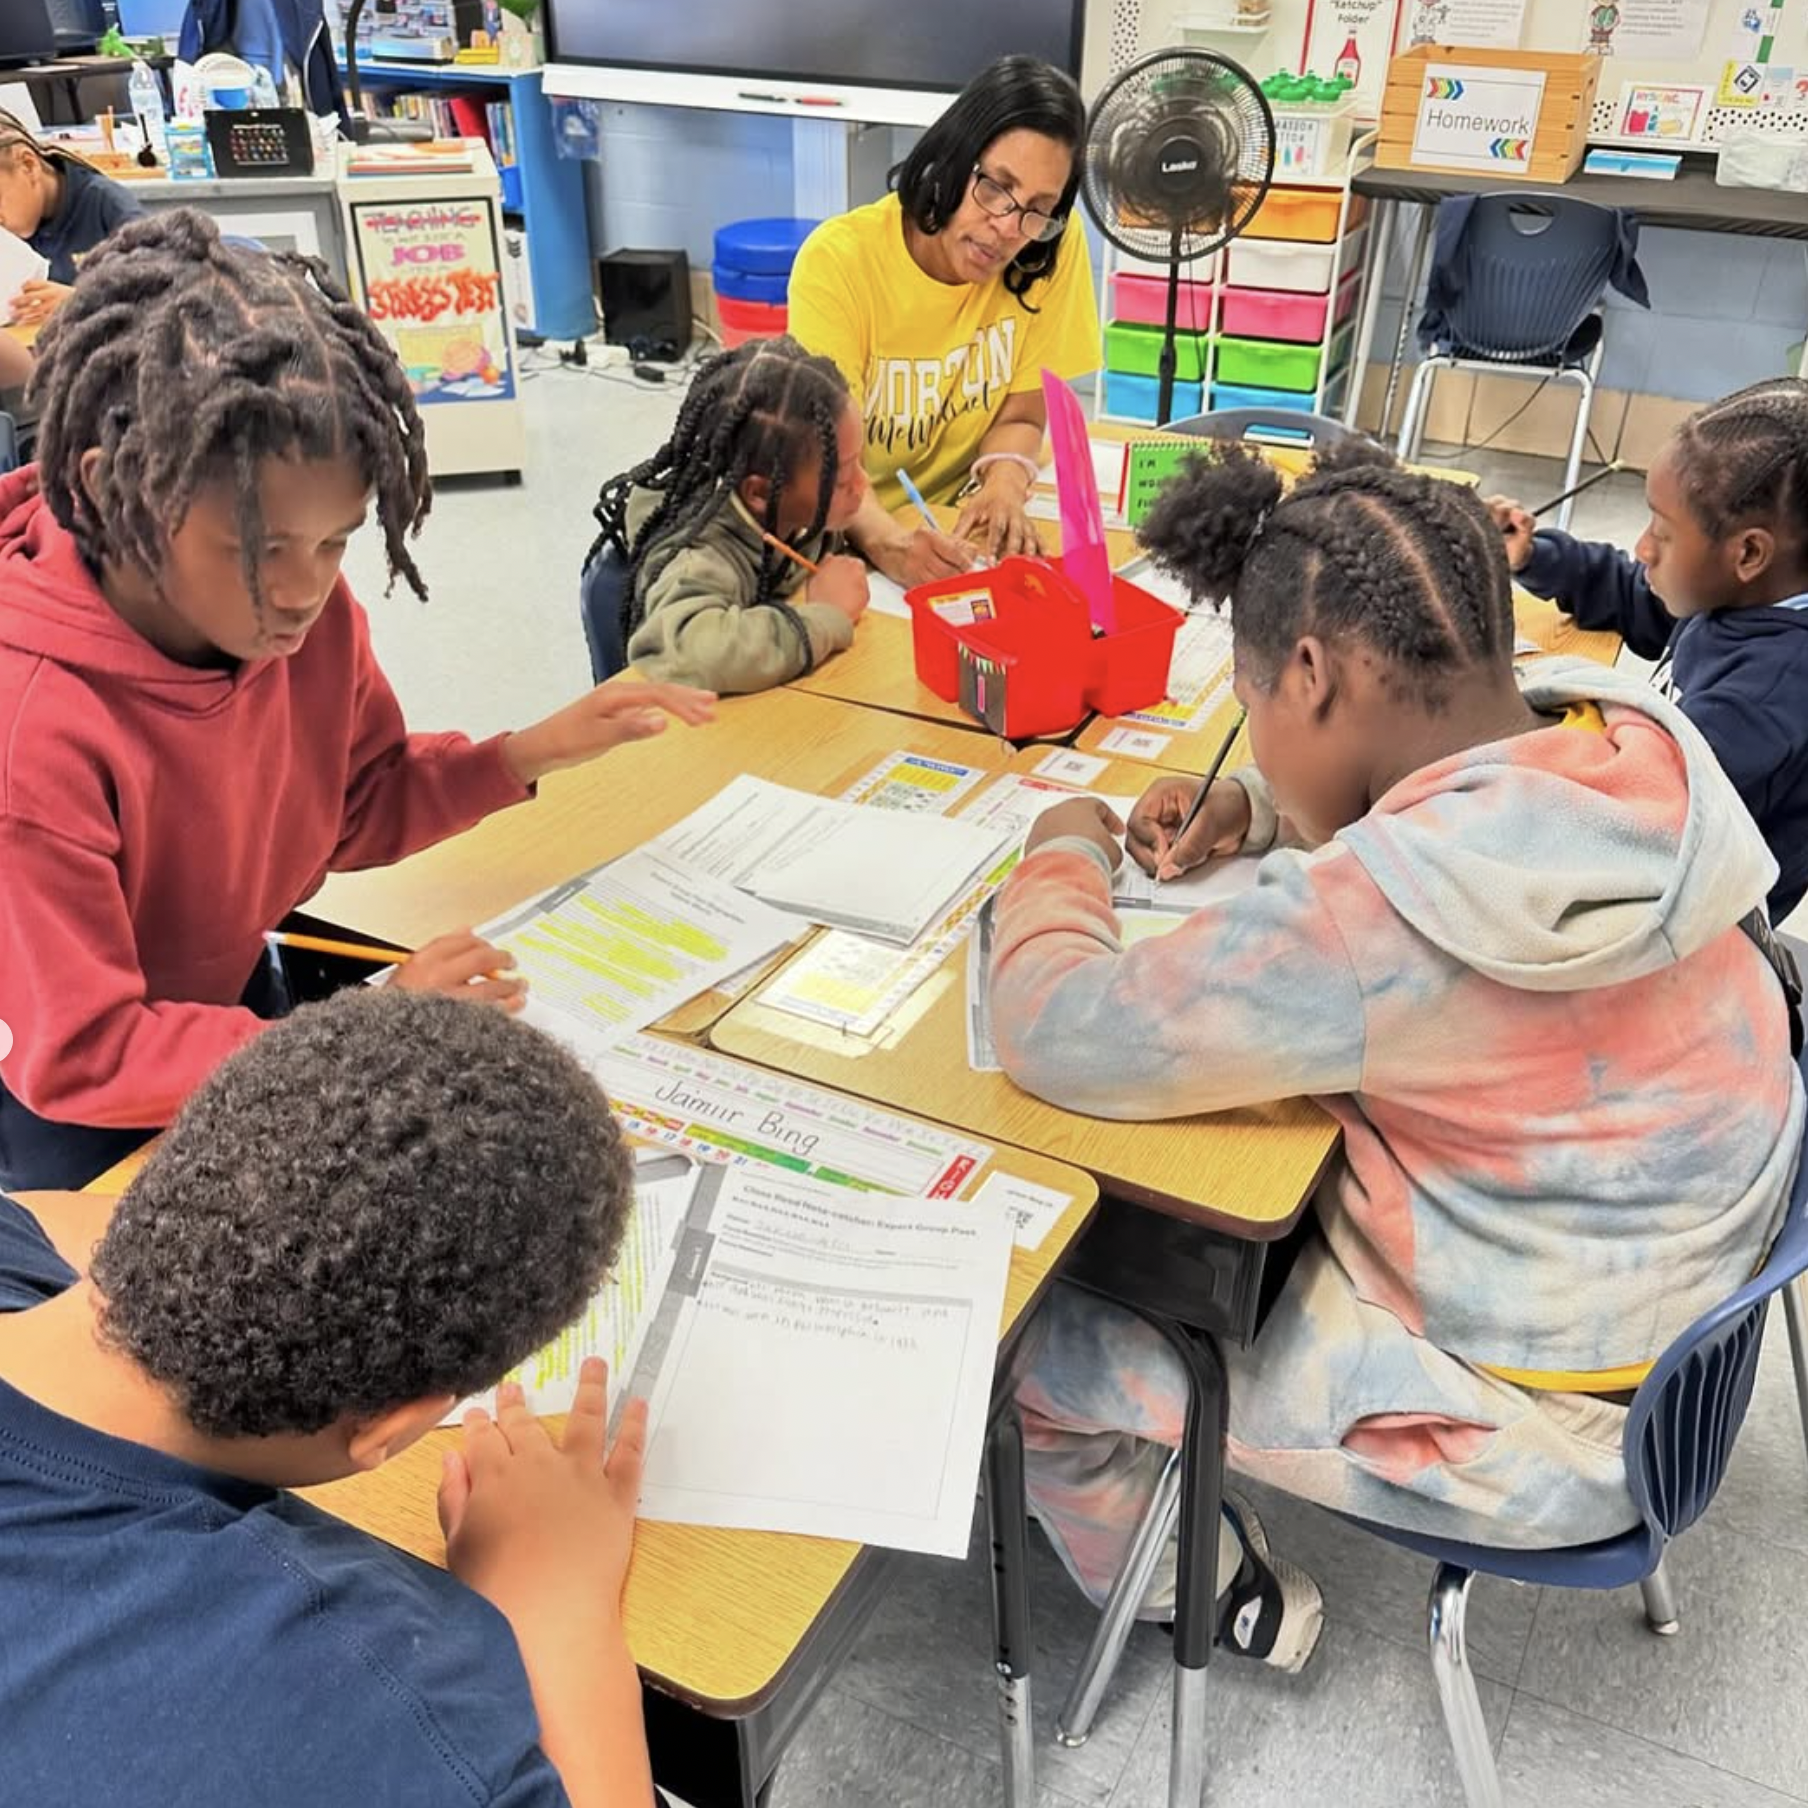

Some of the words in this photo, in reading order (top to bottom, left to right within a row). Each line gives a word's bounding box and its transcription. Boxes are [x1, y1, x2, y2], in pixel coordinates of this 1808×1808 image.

[1338, 13, 1370, 24] Folder
[1427, 108, 1530, 134] Homework
[391, 243, 465, 267] JOB
[757, 1110, 820, 1156] Bing
